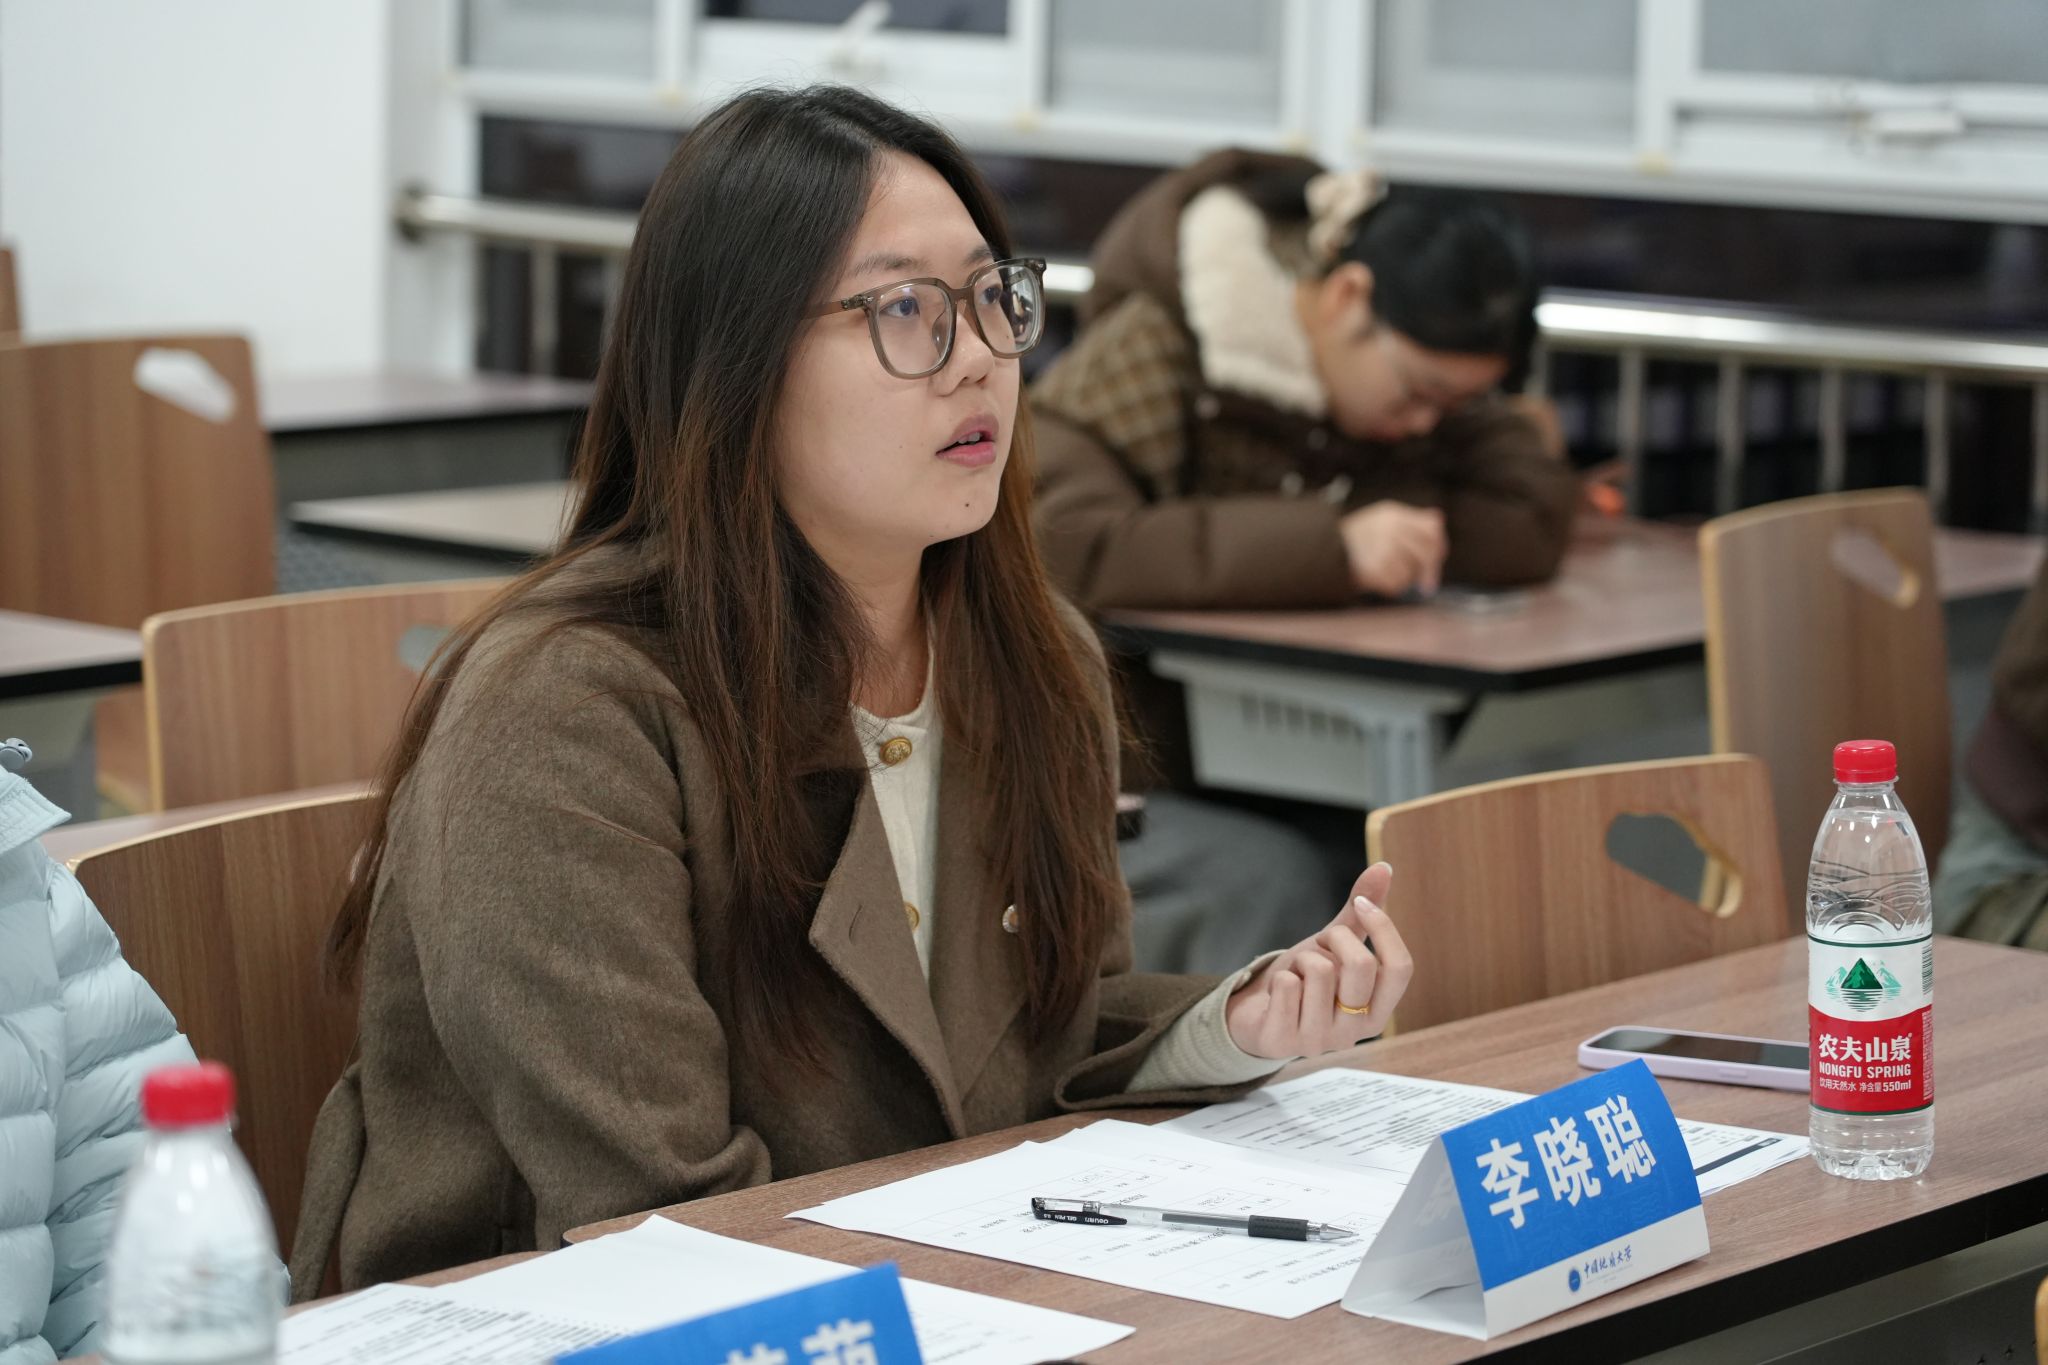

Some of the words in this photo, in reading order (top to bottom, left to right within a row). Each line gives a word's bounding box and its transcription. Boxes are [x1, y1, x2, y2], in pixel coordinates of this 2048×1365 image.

[1819, 1033, 1912, 1062] 农夫山泉
[1819, 1061, 1862, 1079] NONGFU
[1867, 1063, 1911, 1079] SPRING
[1819, 1078, 1857, 1092] 饮用天然水
[1476, 1094, 1657, 1229] 李晓聪
